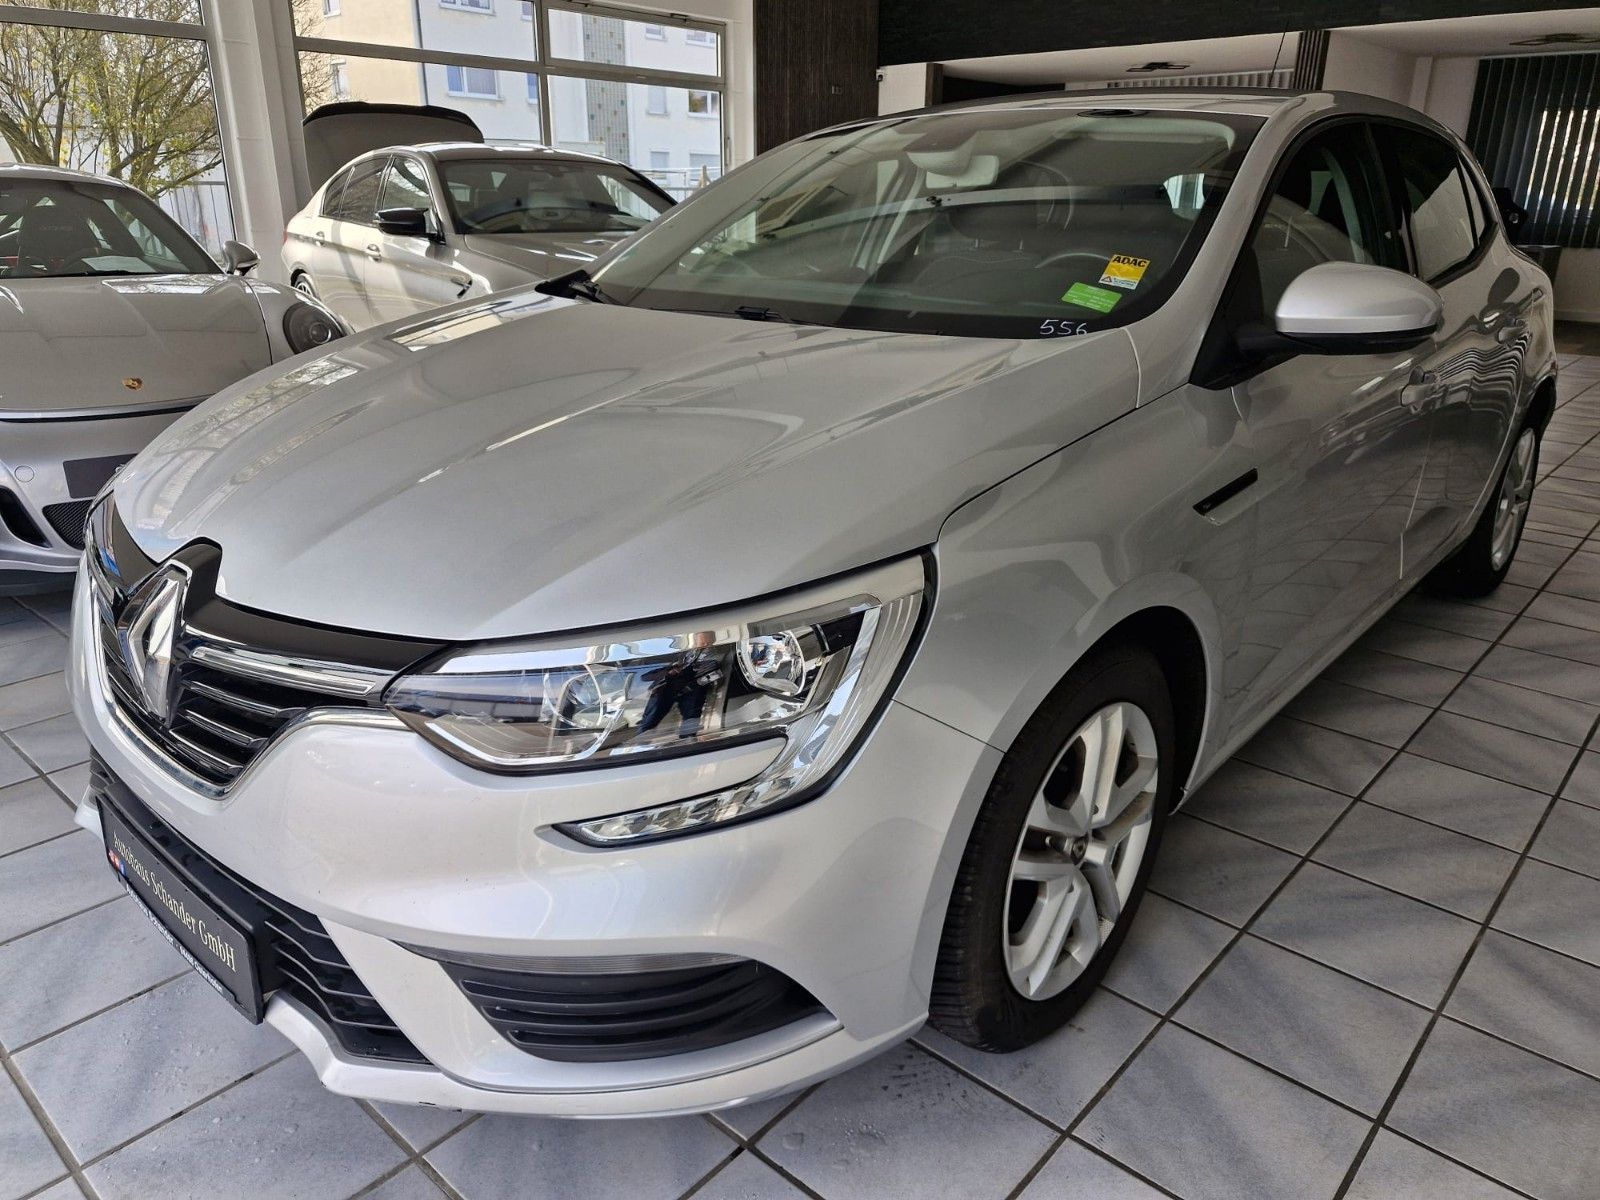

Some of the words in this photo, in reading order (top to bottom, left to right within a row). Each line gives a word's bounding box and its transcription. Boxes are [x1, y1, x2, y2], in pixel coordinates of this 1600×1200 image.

[1112, 255, 1147, 268] ADAC
[1040, 319, 1087, 336] 556
[113, 831, 151, 886] Autohaus
[150, 872, 196, 934] Schander
[198, 919, 236, 972] GmbH
